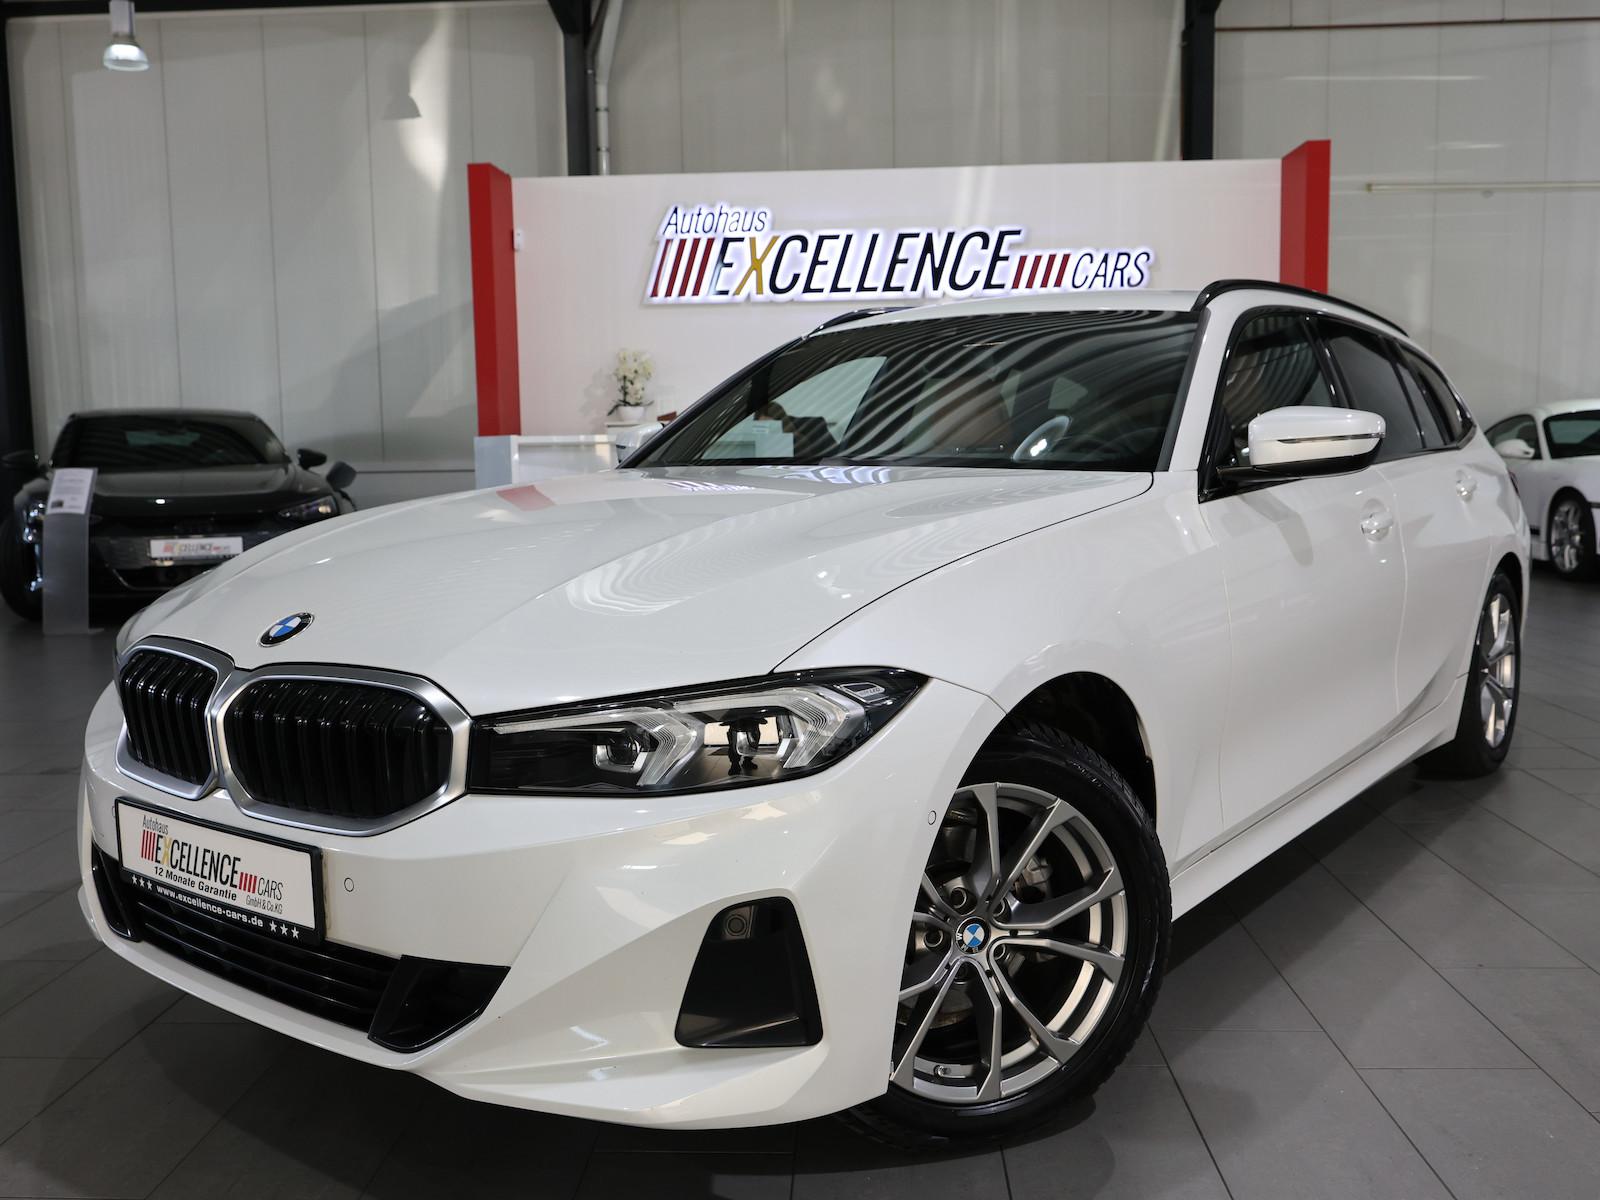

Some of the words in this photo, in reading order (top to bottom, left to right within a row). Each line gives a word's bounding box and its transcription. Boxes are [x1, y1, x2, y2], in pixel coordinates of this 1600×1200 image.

[662, 205, 768, 235] Autohaus
[709, 228, 1022, 297] EXCELLENCE
[1071, 251, 1150, 289] CARS
[142, 815, 169, 835] Autohaus
[154, 866, 164, 876] 12
[165, 869, 196, 888] Monate
[198, 881, 237, 901] Garantie
[155, 834, 241, 889] EXCELLENCE
[257, 877, 284, 901] CARS
[156, 885, 264, 927] www.excellence-cars.de
